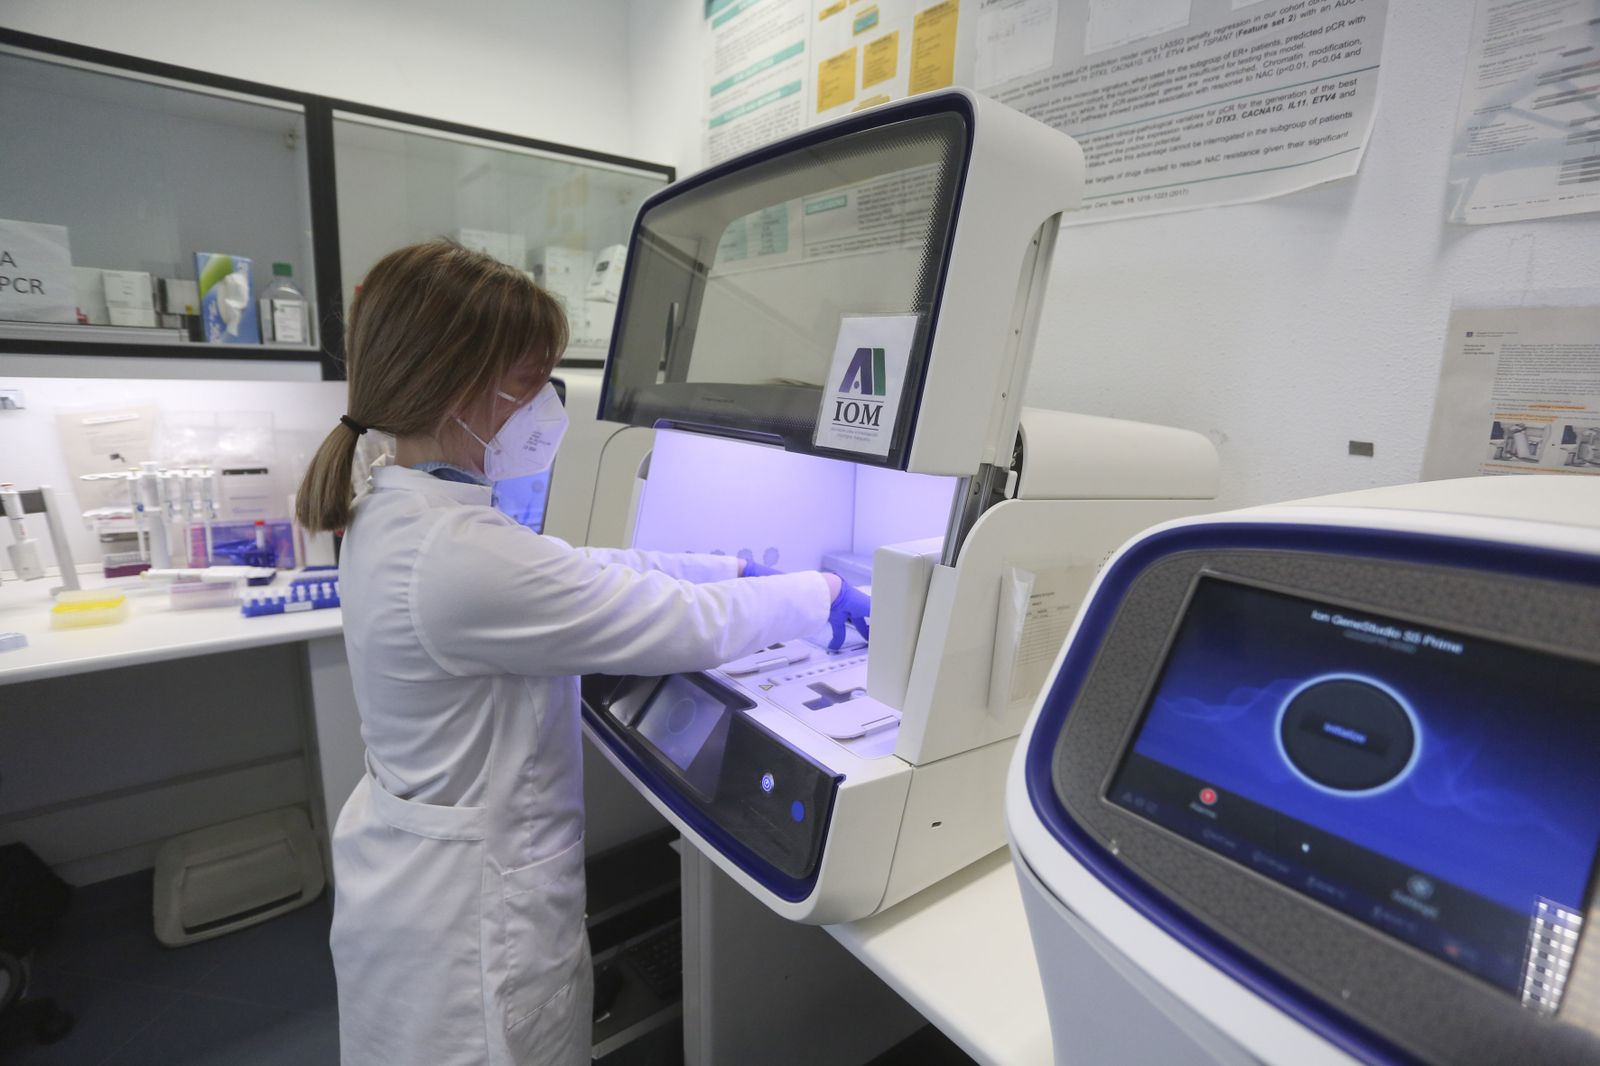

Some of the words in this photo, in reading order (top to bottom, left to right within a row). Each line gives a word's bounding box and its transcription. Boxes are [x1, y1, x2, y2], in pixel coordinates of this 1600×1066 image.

[1159, 36, 1183, 50] LASSO
[1186, 29, 1210, 43] penalty
[1212, 17, 1251, 36] regression
[1253, 14, 1260, 22] in
[1263, 10, 1276, 19] our
[1279, 1, 1304, 15] cohort
[1167, 66, 1175, 74] for
[1177, 63, 1187, 72] the
[1190, 54, 1220, 70] subgroup
[1223, 51, 1230, 59] of
[1232, 46, 1248, 57] ER+
[1285, 26, 1323, 44] predicted
[1324, 19, 1345, 33] pCR
[1348, 14, 1365, 26] with
[1187, 41, 1199, 51] and
[1235, 21, 1267, 37] (Feature
[1272, 17, 1283, 27] set
[1288, 12, 1296, 23] 2)
[1300, 7, 1315, 19] with
[1320, 4, 1330, 13] an
[1158, 89, 1193, 104] association
[1195, 85, 1208, 95] with
[1210, 77, 1242, 92] response
[1245, 74, 1253, 82] to
[1255, 68, 1272, 79] NAC
[1276, 59, 1308, 76] (p<0.01,
[1311, 51, 1340, 67] p<0.04
[1344, 47, 1361, 58] and
[1189, 62, 1224, 78] insufficient
[1226, 60, 1235, 68] for
[1237, 53, 1261, 66] testing
[1264, 48, 1276, 58] this
[1202, 74, 1219, 84] more
[1263, 51, 1302, 69] Chromatin
[1309, 35, 1361, 58] modification,
[1182, 121, 1203, 131] values
[1312, 91, 1335, 104] ETV4
[1339, 88, 1355, 99] and
[1206, 108, 1215, 116] for
[1218, 104, 1234, 115] pCR
[1237, 101, 1247, 109] for
[1250, 98, 1261, 107] the
[1265, 88, 1306, 105] generation
[1309, 86, 1317, 95] of
[1321, 82, 1334, 92] the
[1338, 77, 1357, 89] best
[1143, 163, 1168, 174] directed
[1179, 158, 1201, 168] rescue
[1204, 153, 1220, 163] NAC
[1223, 147, 1259, 161] resistance
[1263, 143, 1283, 155] given
[1287, 139, 1304, 149] their
[1308, 129, 1348, 147] significant
[1169, 142, 1191, 152] cannot
[1203, 131, 1244, 147] interrogated
[1255, 127, 1267, 135] the
[1270, 119, 1306, 135] subgroup
[1308, 116, 1317, 126] of
[1319, 110, 1352, 125] patients
[0, 251, 17, 268] A
[0, 275, 45, 295] PCR
[833, 401, 884, 427] IOM
[1331, 614, 1402, 639] GeneStudio
[1422, 634, 1464, 655] Prime
